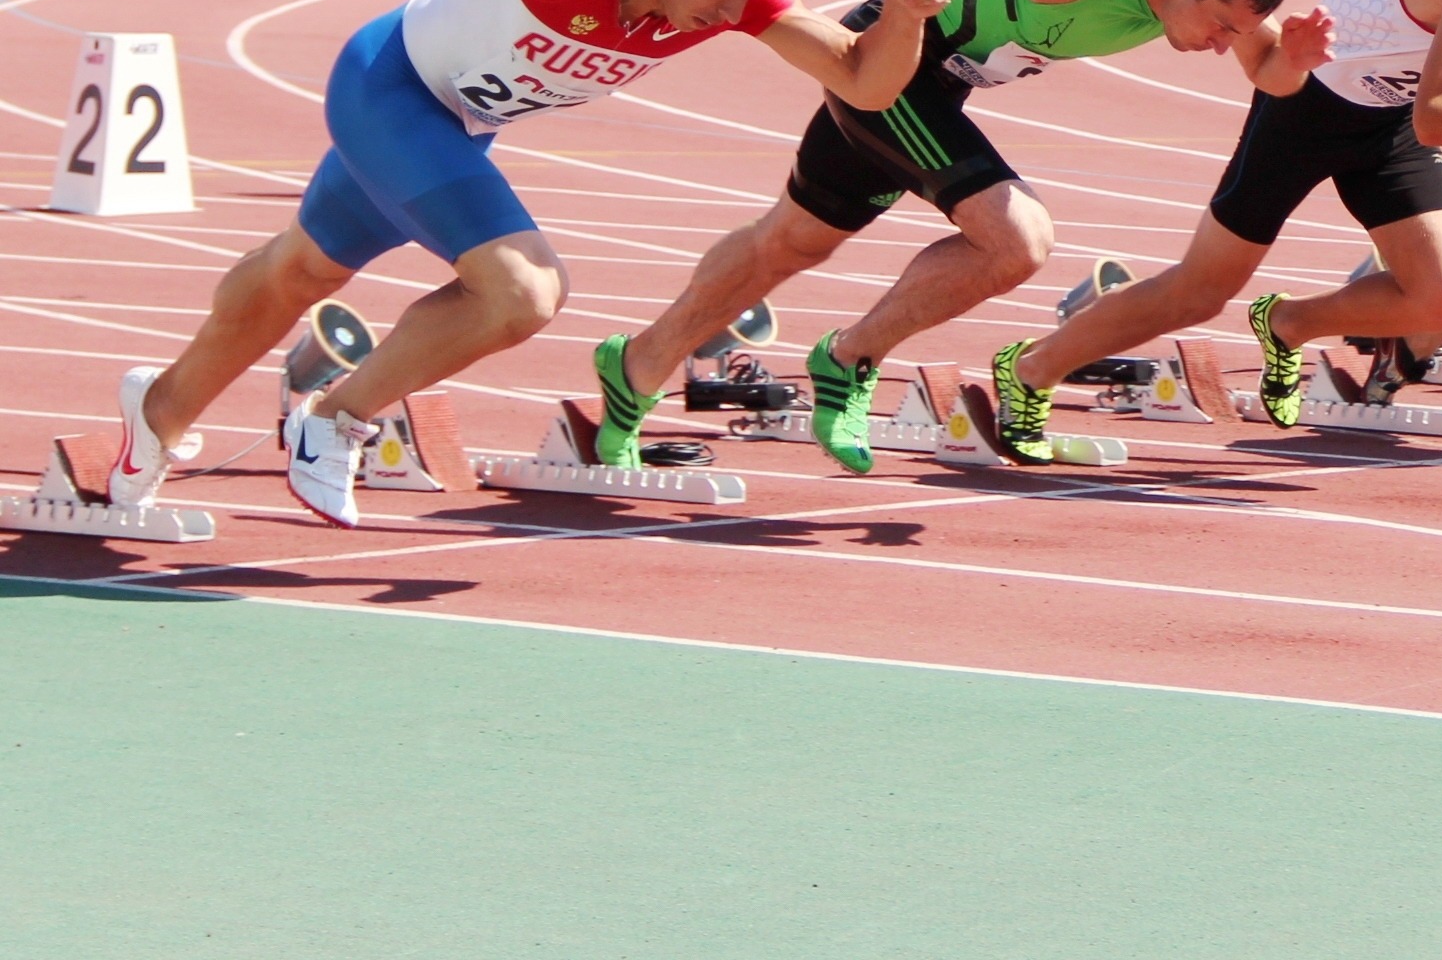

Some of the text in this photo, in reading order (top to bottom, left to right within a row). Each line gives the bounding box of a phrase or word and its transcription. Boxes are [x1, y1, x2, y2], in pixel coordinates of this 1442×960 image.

[513, 32, 664, 86] RUSSI
[1378, 70, 1421, 96] 2
[67, 83, 103, 176] 2
[125, 84, 166, 173] 2
